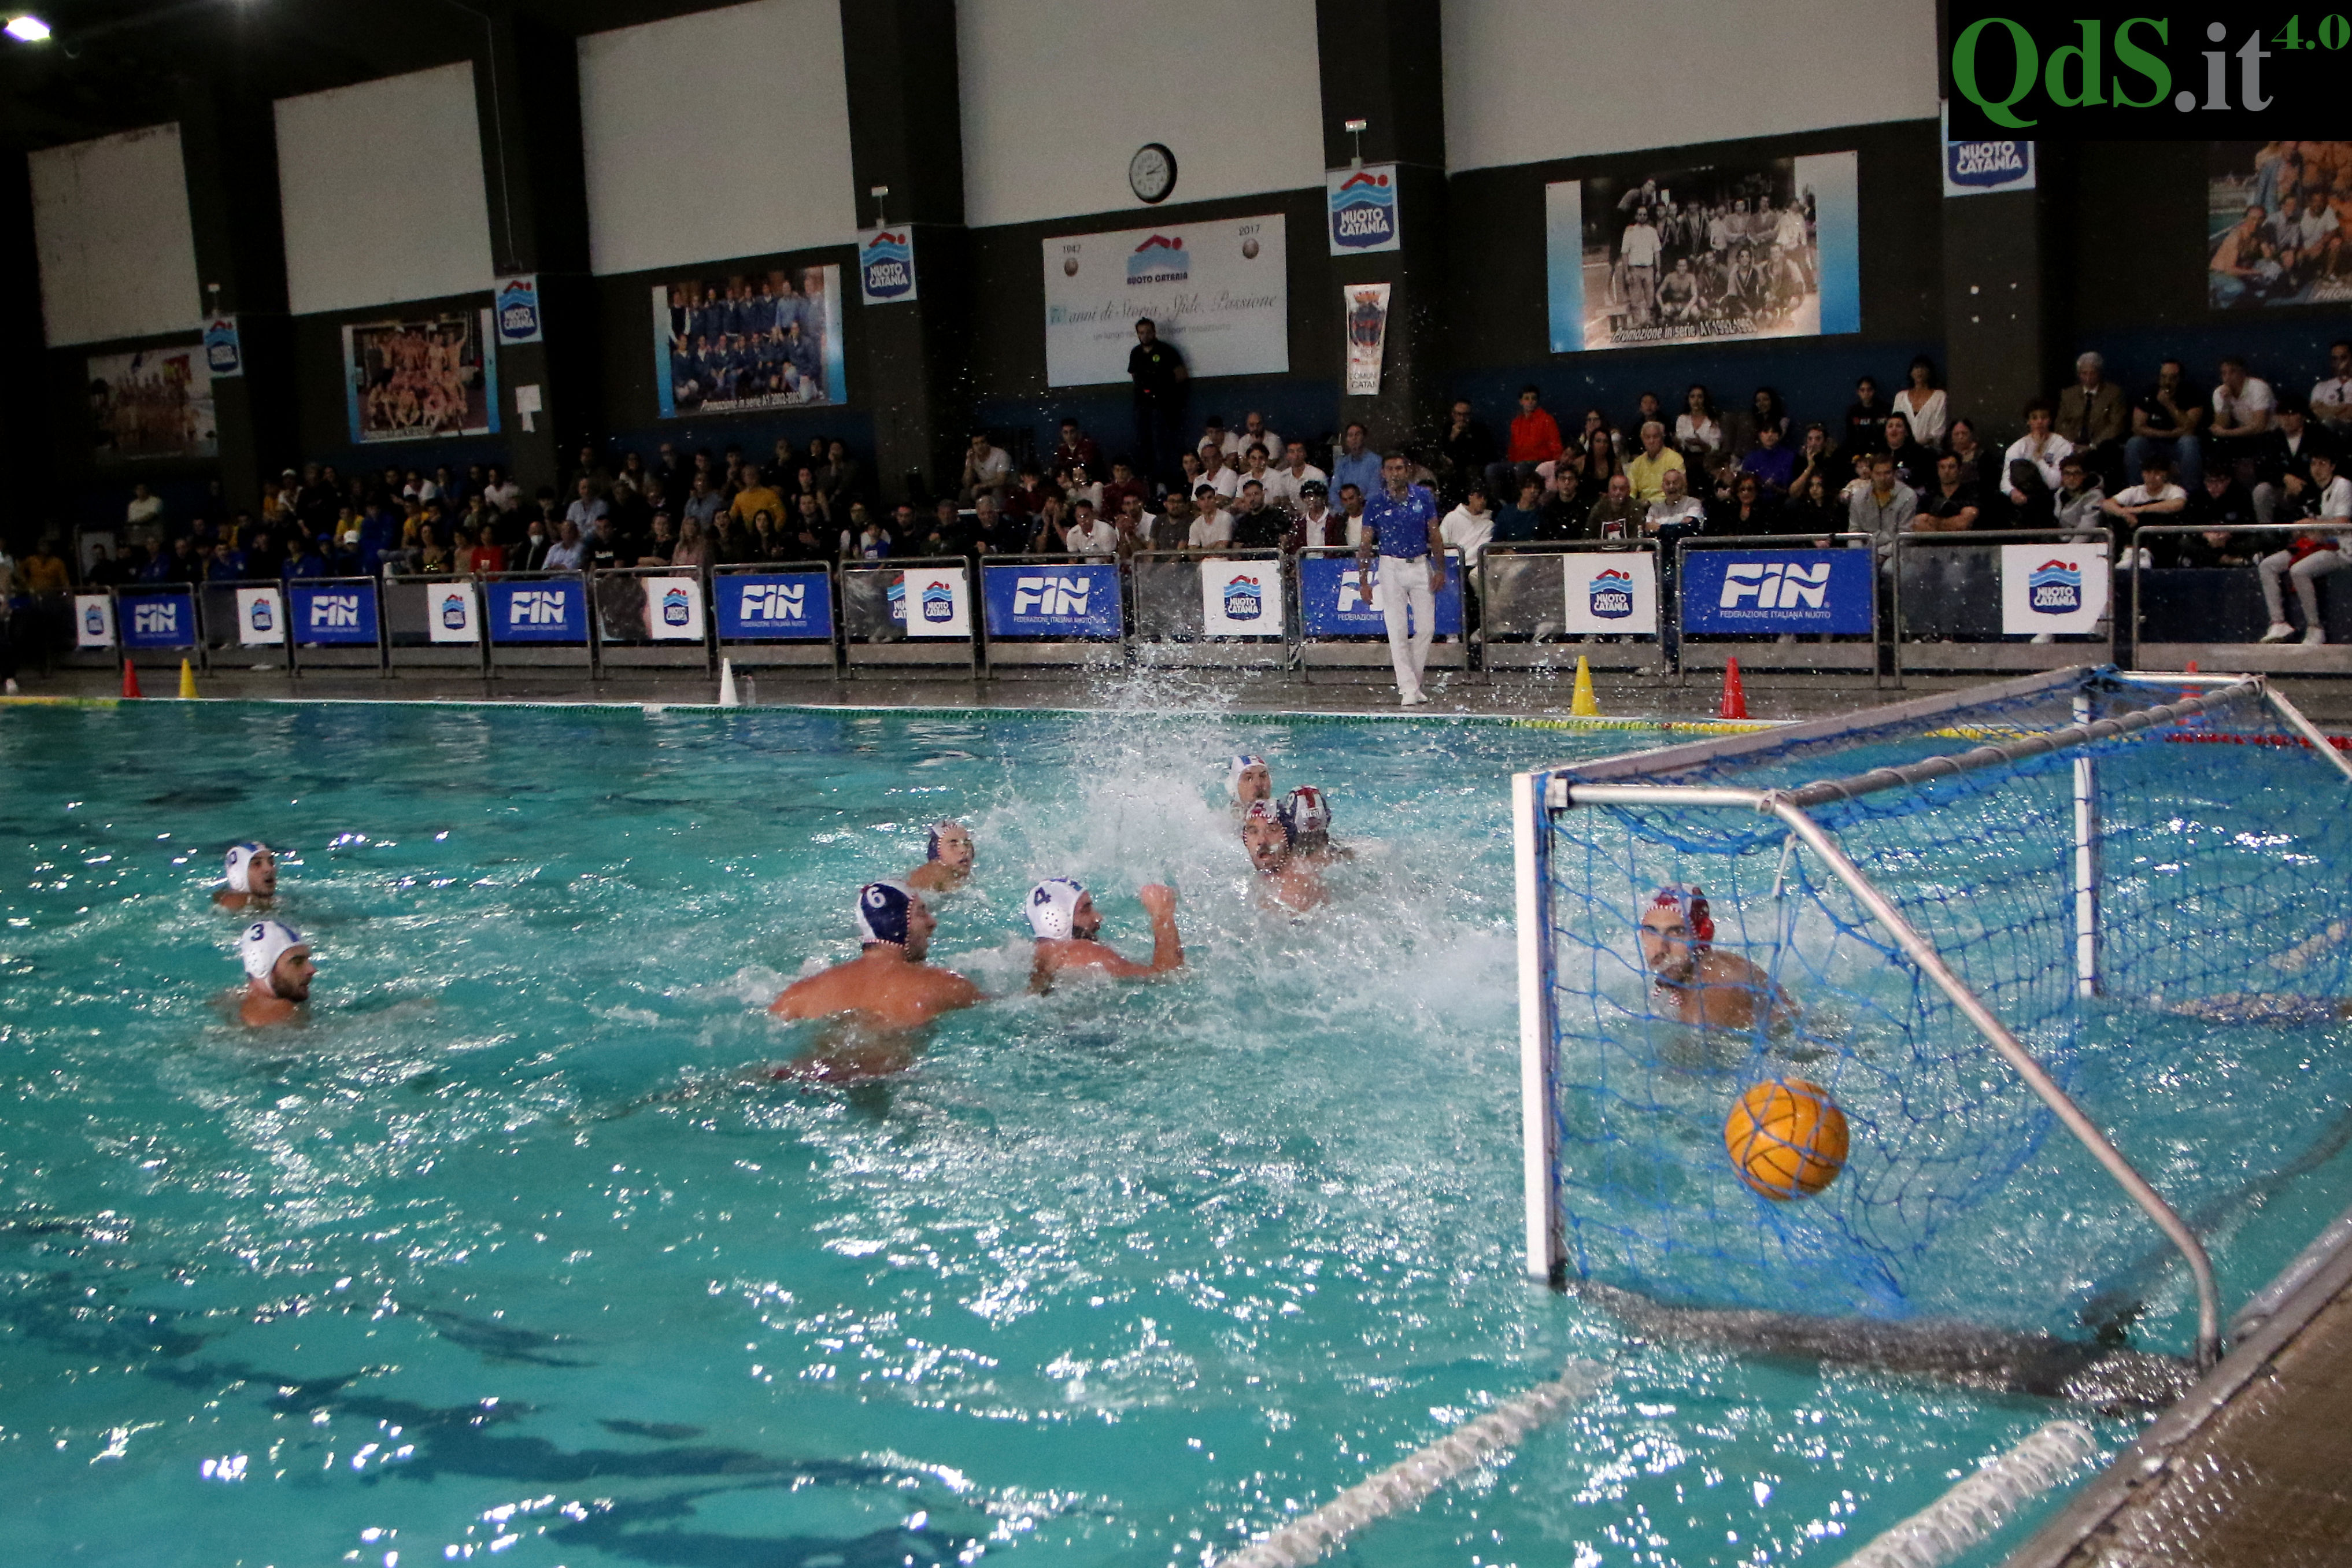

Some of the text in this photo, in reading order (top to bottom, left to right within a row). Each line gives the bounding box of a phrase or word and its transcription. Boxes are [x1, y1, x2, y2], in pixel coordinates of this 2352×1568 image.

[1959, 141, 2015, 161] NUOTO
[1957, 153, 2023, 174] CATANIA
[1341, 208, 1384, 224] NUOTO
[1239, 225, 1260, 236] 2017
[1339, 220, 1390, 236] CATANIA
[1063, 245, 1081, 254] 1947
[870, 262, 903, 278] NUOTO
[870, 273, 908, 287] CATANIA
[1127, 272, 1188, 285] NUOTO CATANIA
[1610, 325, 1662, 342] Promozione
[1665, 324, 1673, 338] in
[1674, 321, 1696, 337] serie
[1720, 563, 1830, 608] FIN
[2037, 586, 2074, 597] NUOTO
[740, 584, 805, 619] FIN
[1014, 577, 1090, 615] FIN
[1230, 597, 1256, 607] NUOTO
[1596, 593, 1627, 603] NUOTO
[2034, 596, 2078, 607] CATANIA
[311, 596, 358, 626] FIN
[511, 591, 565, 624] FIN
[894, 601, 906, 610] NU
[927, 601, 949, 610] NUOTO
[1228, 605, 1259, 614] CATANIA
[1593, 602, 1630, 611] CATANIA
[135, 603, 176, 633] FIN
[1805, 611, 1830, 619] NUOTO
[867, 886, 887, 908] 6
[1034, 887, 1052, 906] 4
[250, 924, 265, 941] 3
